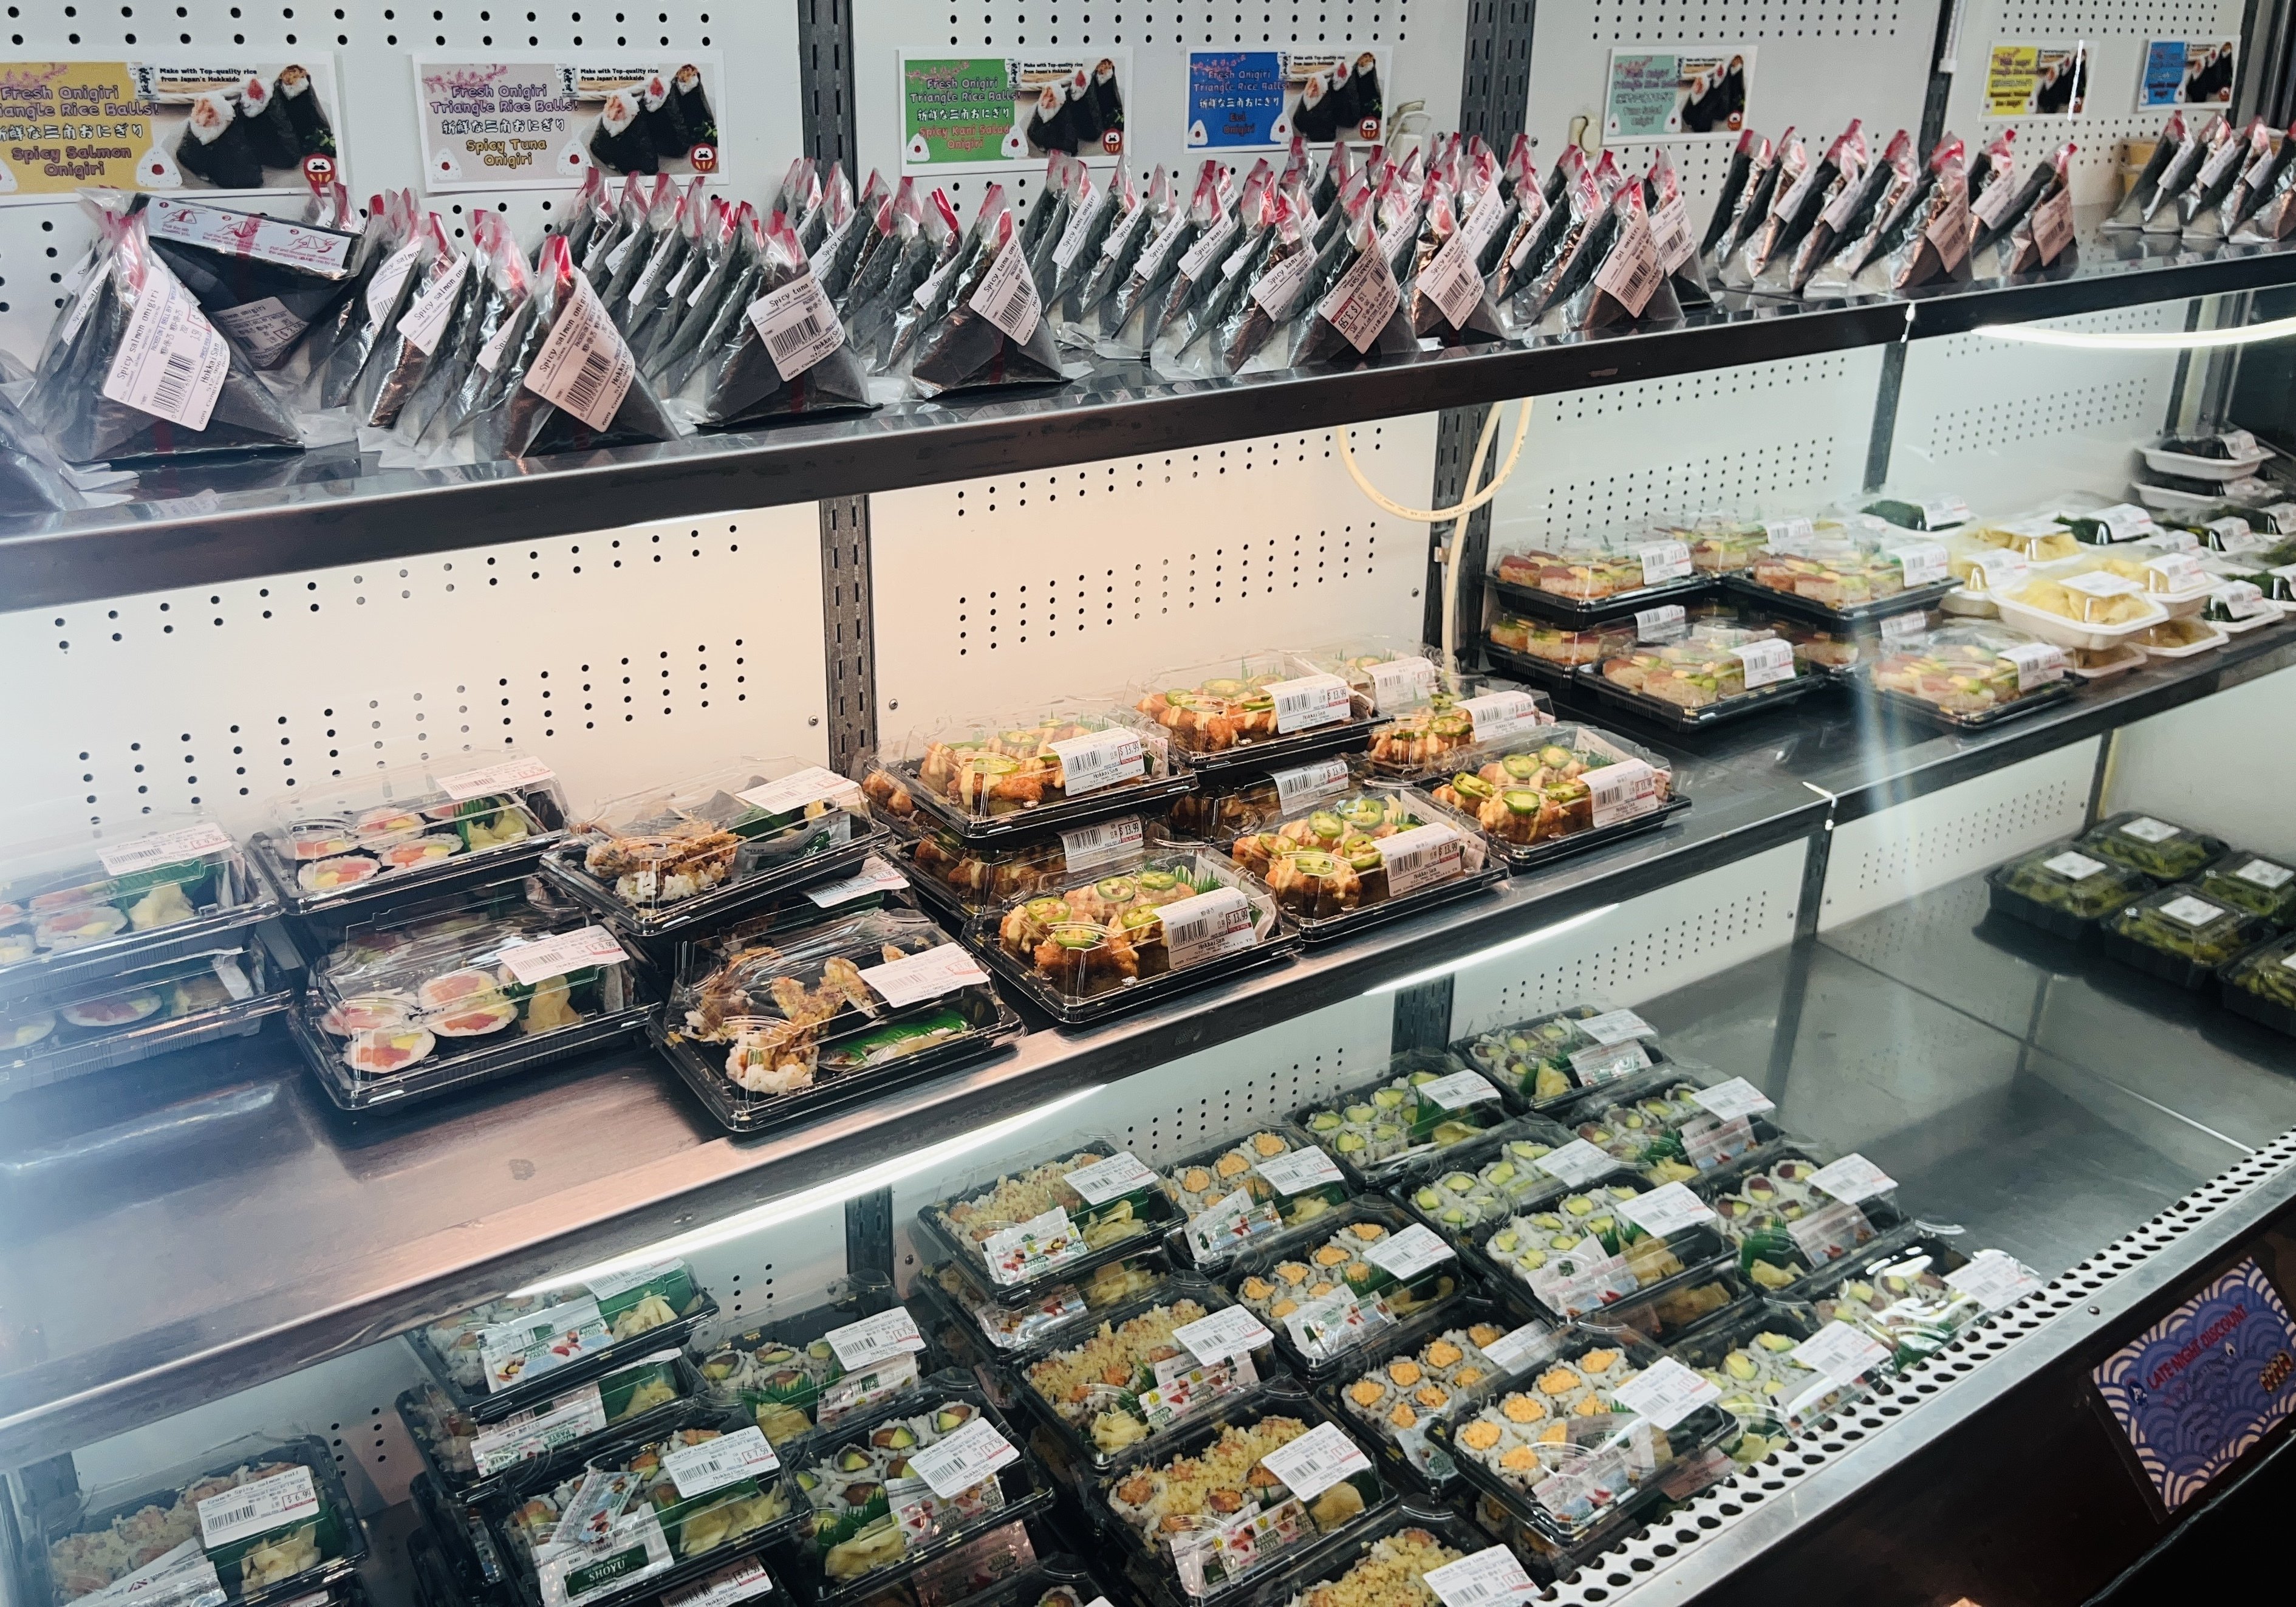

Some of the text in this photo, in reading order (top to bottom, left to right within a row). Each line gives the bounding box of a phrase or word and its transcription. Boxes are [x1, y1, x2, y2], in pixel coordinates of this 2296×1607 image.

[451, 84, 547, 101] Fresh Onigiri
[926, 77, 998, 91] Fresh Onigiri
[1194, 81, 1234, 94] Triangle
[1, 85, 119, 103] Fresh Onigiri
[910, 91, 1021, 106] Triangle Rice Balls!
[61, 101, 160, 117] Rice Balls!
[429, 98, 578, 117] Triangle Rice Balls!
[919, 125, 948, 139] Spicy
[952, 125, 976, 136] Kani
[466, 139, 547, 155] Spicy Tuna
[947, 137, 983, 151] Onigiri
[11, 145, 132, 165] Spicy Salmon
[483, 152, 533, 169] Onigiri
[44, 161, 105, 180] Onigiri
[1062, 194, 1096, 248] Spicy kani onigiri
[1116, 211, 1139, 240] Spicy kani
[822, 239, 838, 259] Spicy
[1149, 229, 1174, 260] Spicy kani
[1194, 228, 1221, 258] Spicy kani
[1430, 244, 1454, 276] Spicy kani
[983, 254, 1009, 294] Spicy tuna
[1266, 256, 1297, 286] Spicy kani
[413, 277, 456, 323] Spicy salmon
[768, 283, 810, 309] Spicy tuna
[1337, 309, 1353, 331] 3.59
[116, 289, 160, 380] Spicy salmon onigiri
[539, 347, 558, 374] Spicy
[554, 317, 575, 348] salmon
[1333, 688, 1346, 699] 13.99
[1125, 742, 1139, 755] 13.99
[1332, 763, 1345, 776] 13.99
[1119, 822, 1139, 836] $ 13.99
[1444, 841, 1457, 854] 13.99
[1226, 908, 1249, 925] $ 13.99
[597, 939, 617, 950] 9.99
[901, 1325, 916, 1335] 7.59
[2146, 1303, 2247, 1390] LATE NIGHT DISCOUNT
[753, 1446, 770, 1457] 7.59
[988, 1437, 1005, 1450] 7.59
[294, 1489, 312, 1501] 6.99
[589, 1560, 625, 1581] SHOYU
